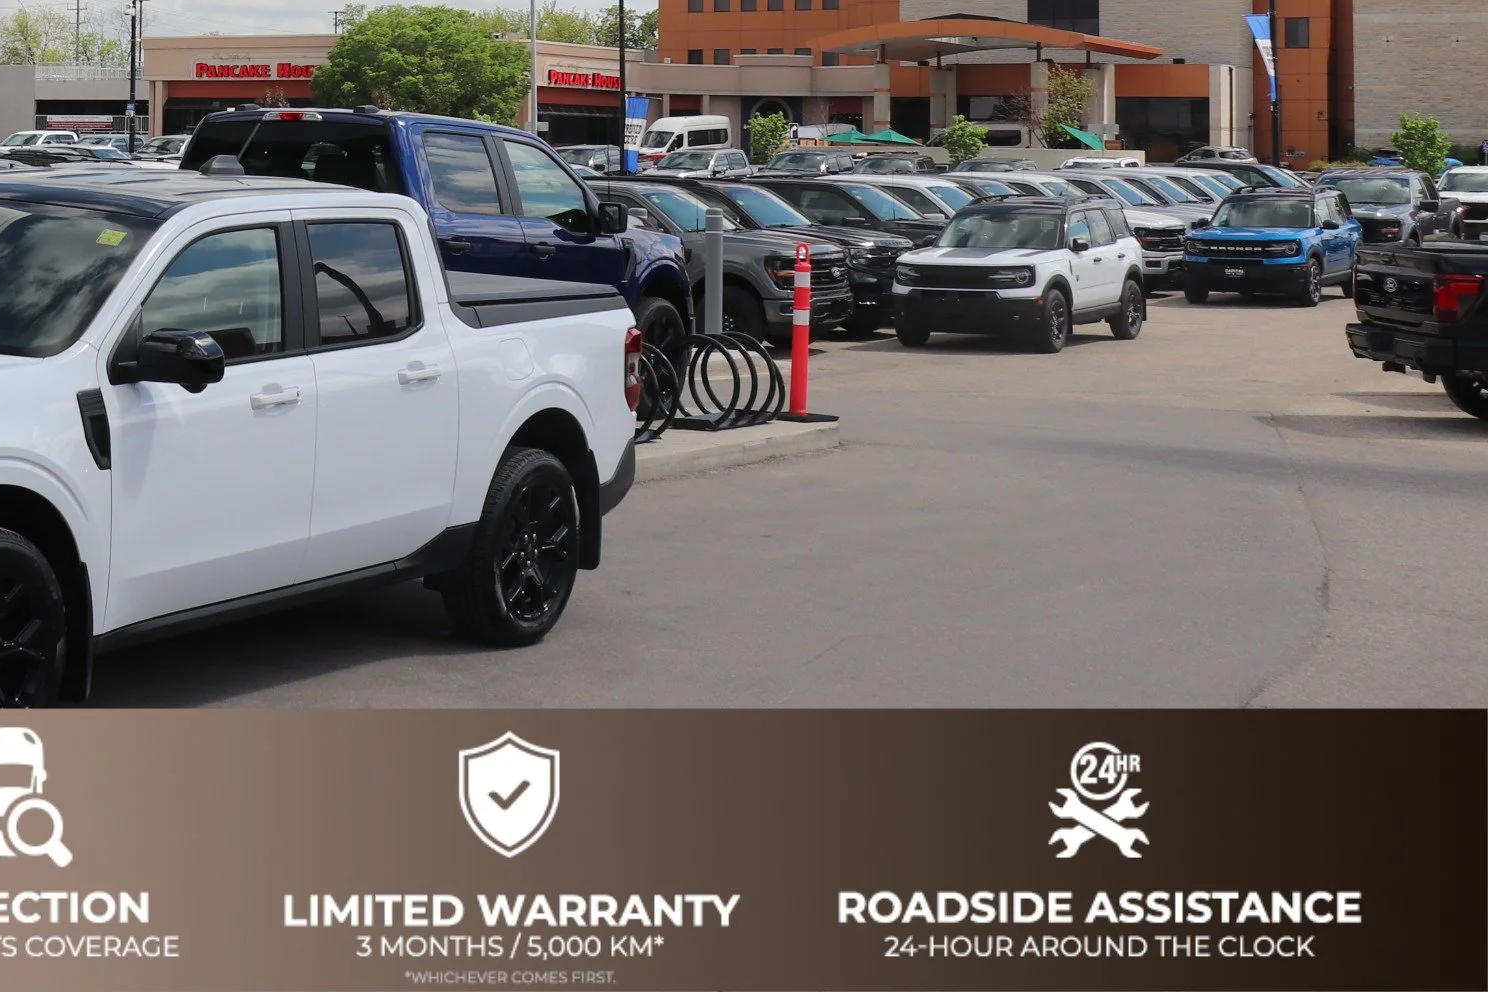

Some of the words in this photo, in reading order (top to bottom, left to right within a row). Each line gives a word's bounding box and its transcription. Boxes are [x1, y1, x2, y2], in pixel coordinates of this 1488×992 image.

[195, 62, 271, 78] PANCAKE
[276, 62, 317, 78] HOU
[548, 69, 592, 86] PANCAKE
[592, 72, 621, 89] HOUS
